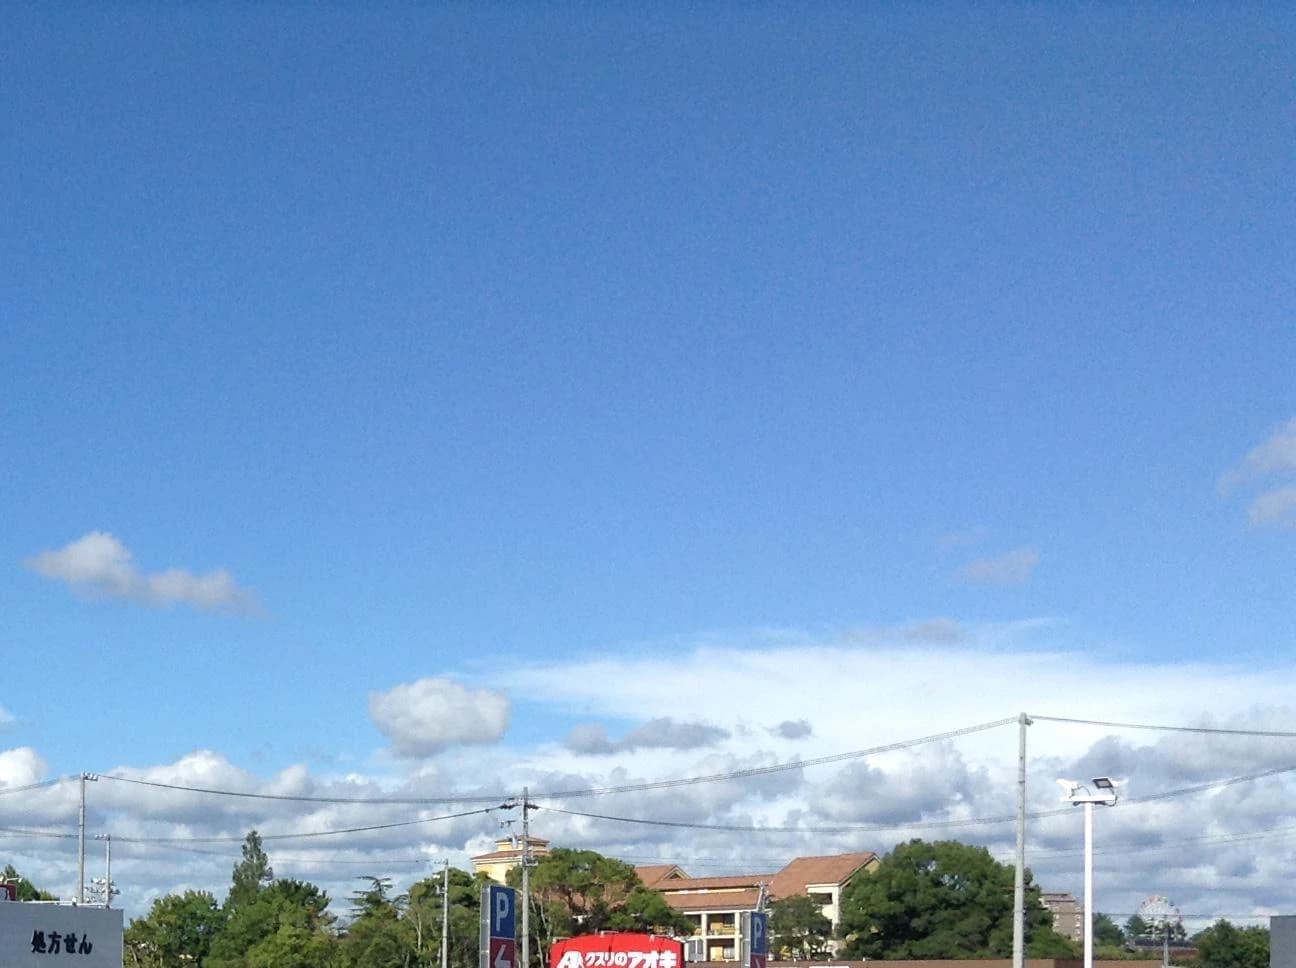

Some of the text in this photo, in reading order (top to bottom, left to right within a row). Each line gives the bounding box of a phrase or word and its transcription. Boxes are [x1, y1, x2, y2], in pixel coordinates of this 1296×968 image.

[496, 891, 509, 932] P
[31, 929, 93, 955] 処方せん
[754, 916, 763, 949] P
